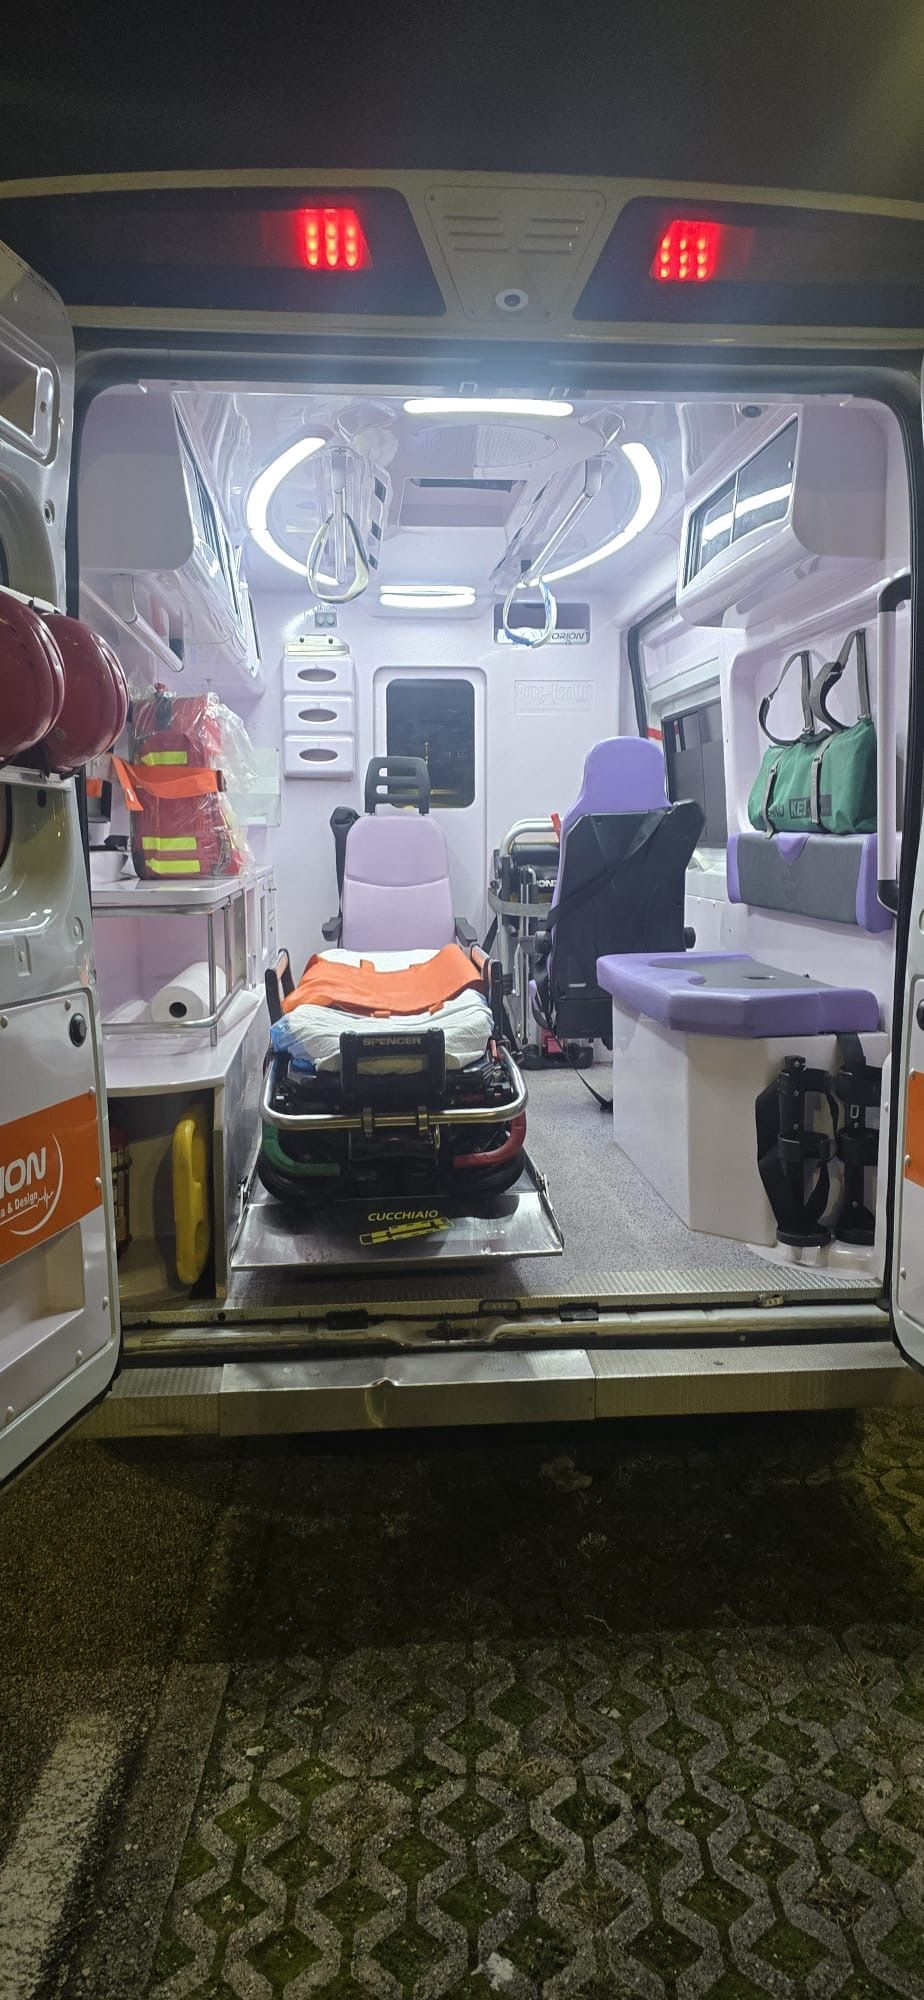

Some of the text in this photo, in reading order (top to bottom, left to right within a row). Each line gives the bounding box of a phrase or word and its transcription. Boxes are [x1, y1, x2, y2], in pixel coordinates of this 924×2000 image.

[551, 632, 584, 640] ORION
[362, 1037, 421, 1046] SPENCER
[15, 1191, 38, 1210] Design
[368, 1210, 438, 1222] CUCCHIAIO
